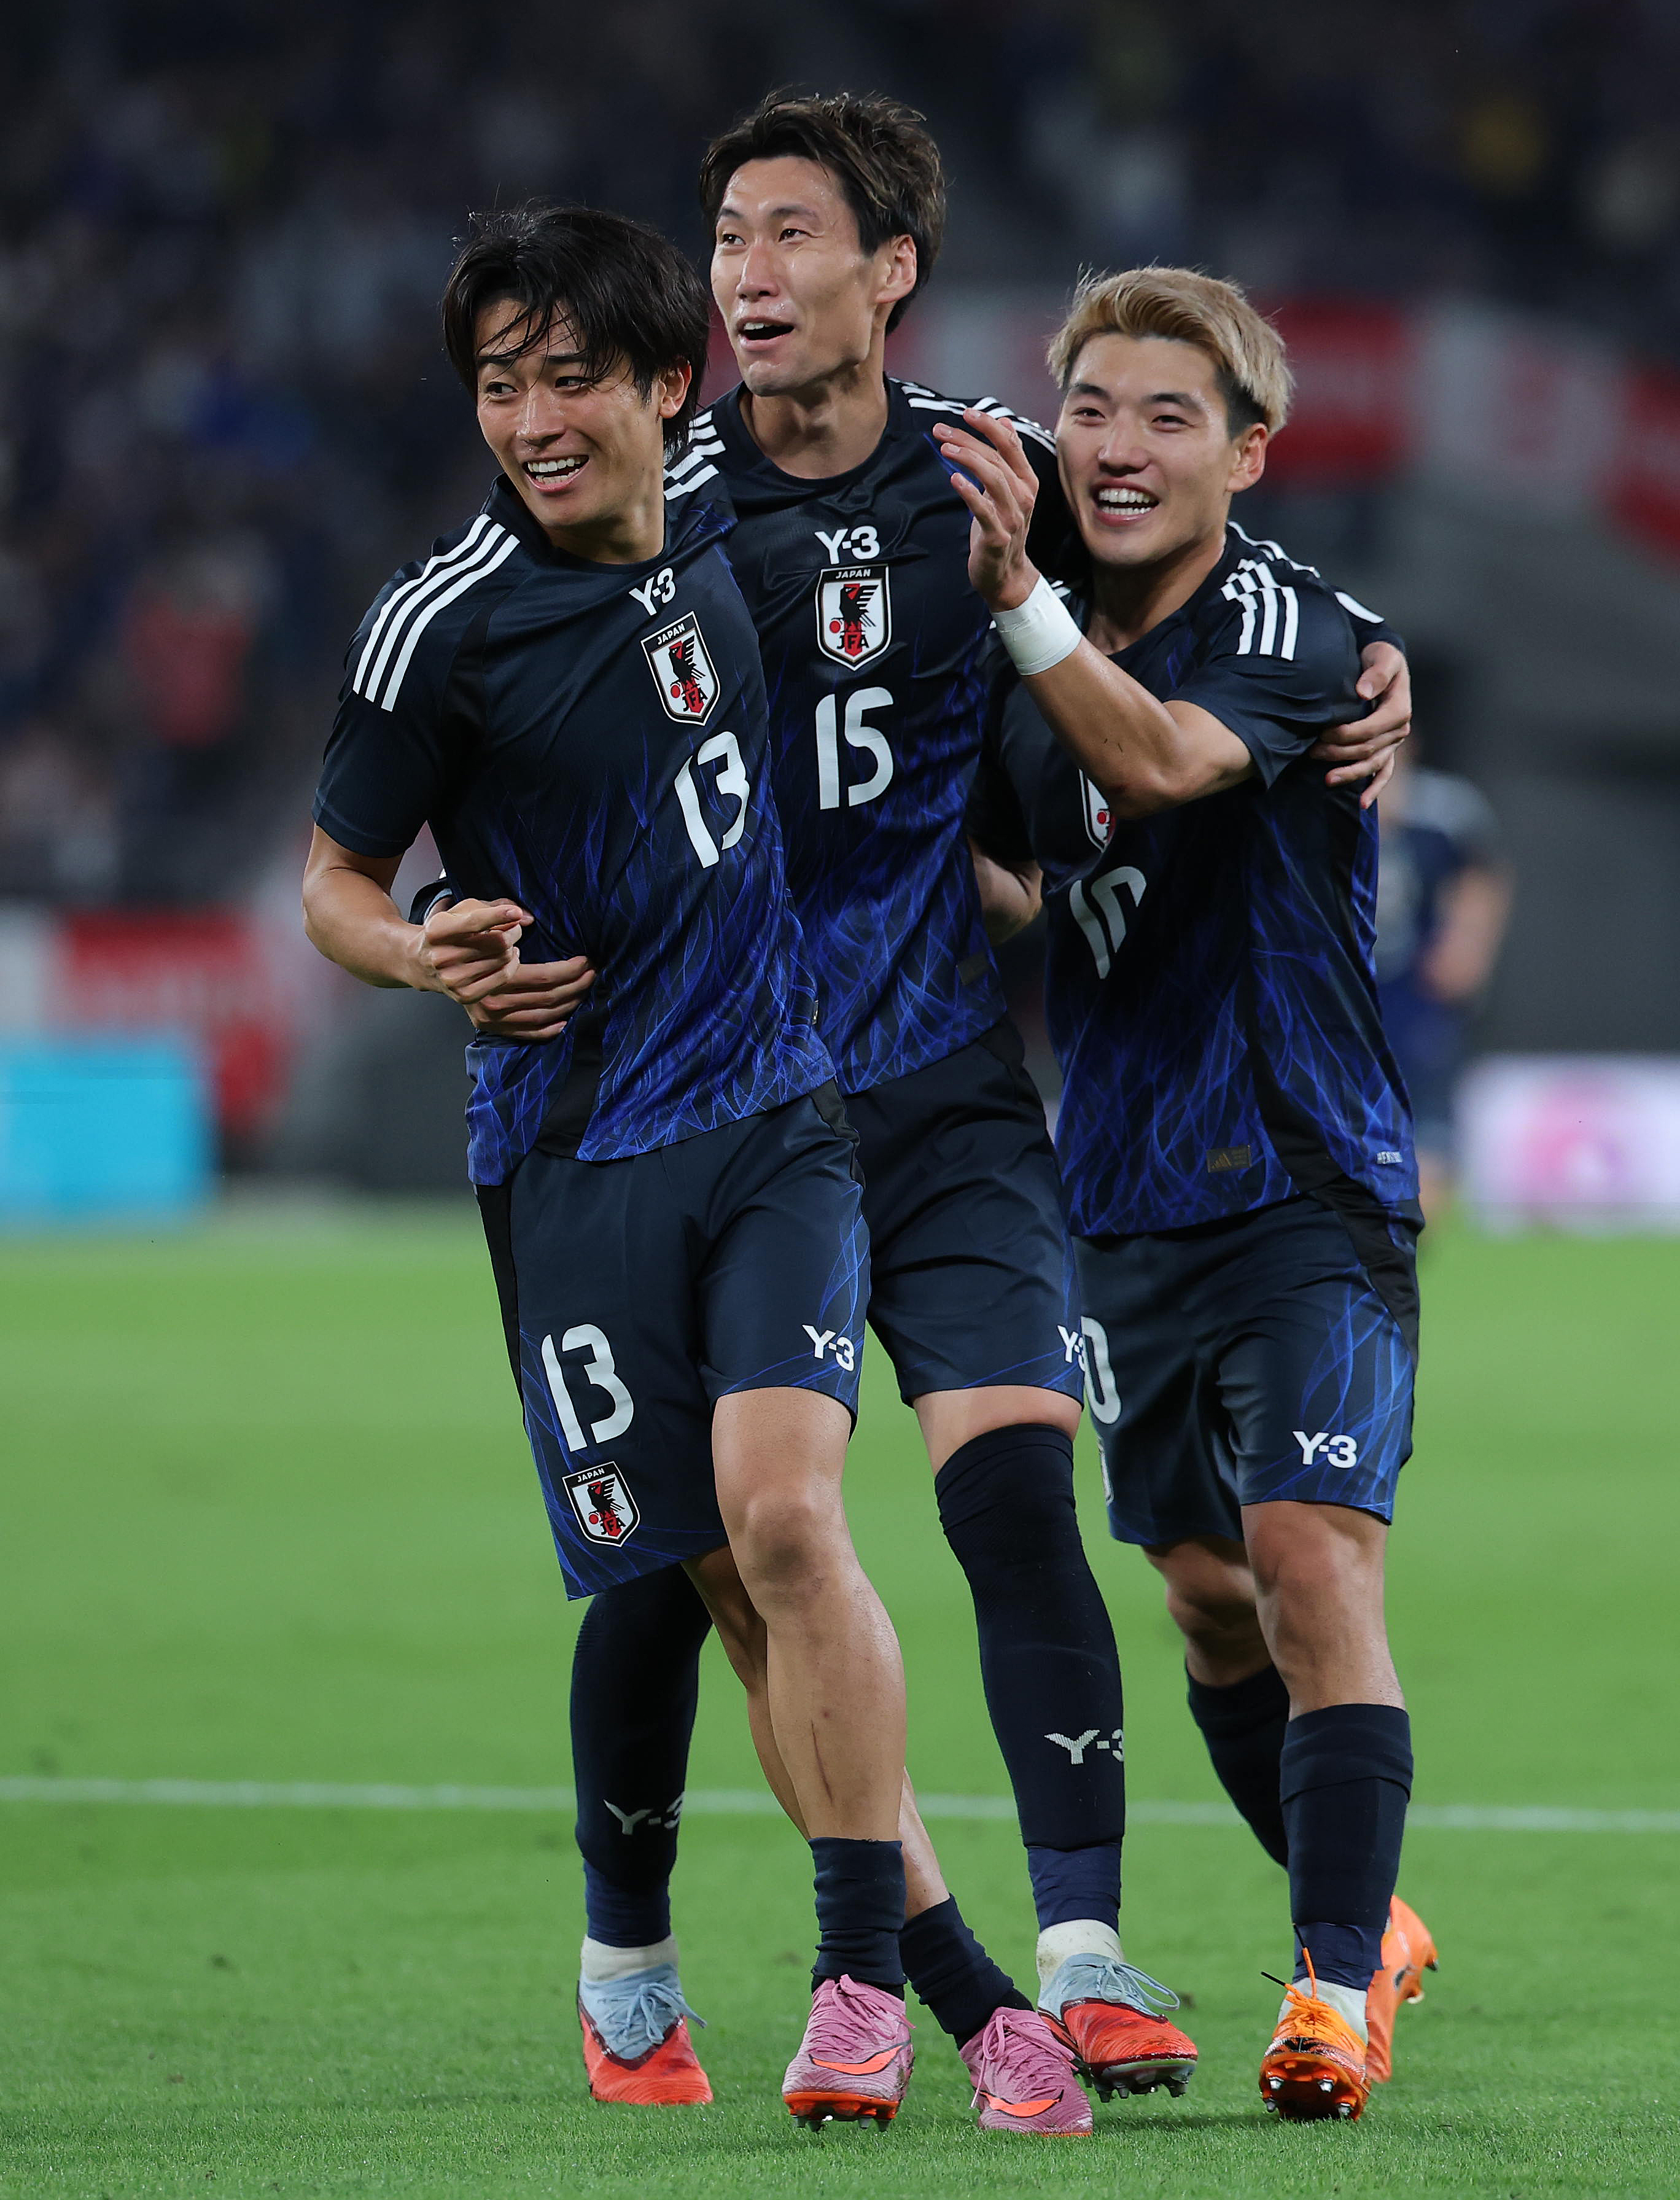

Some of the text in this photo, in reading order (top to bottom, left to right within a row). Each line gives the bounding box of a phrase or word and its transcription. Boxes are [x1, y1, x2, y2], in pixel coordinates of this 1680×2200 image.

[815, 526, 880, 564] Y-3
[629, 567, 676, 616] Y-3
[836, 569, 871, 579] JAPAN
[657, 623, 685, 645] JAPAN
[837, 634, 869, 649] JFA
[682, 687, 708, 712] JFA
[815, 686, 894, 810] 15
[675, 731, 750, 868] 13
[802, 1324, 854, 1371] Y-3
[542, 1324, 634, 1452] 13
[1293, 1431, 1358, 1469] Y-3
[577, 1468, 605, 1482] JAPAN
[601, 1517, 626, 1534] JFA
